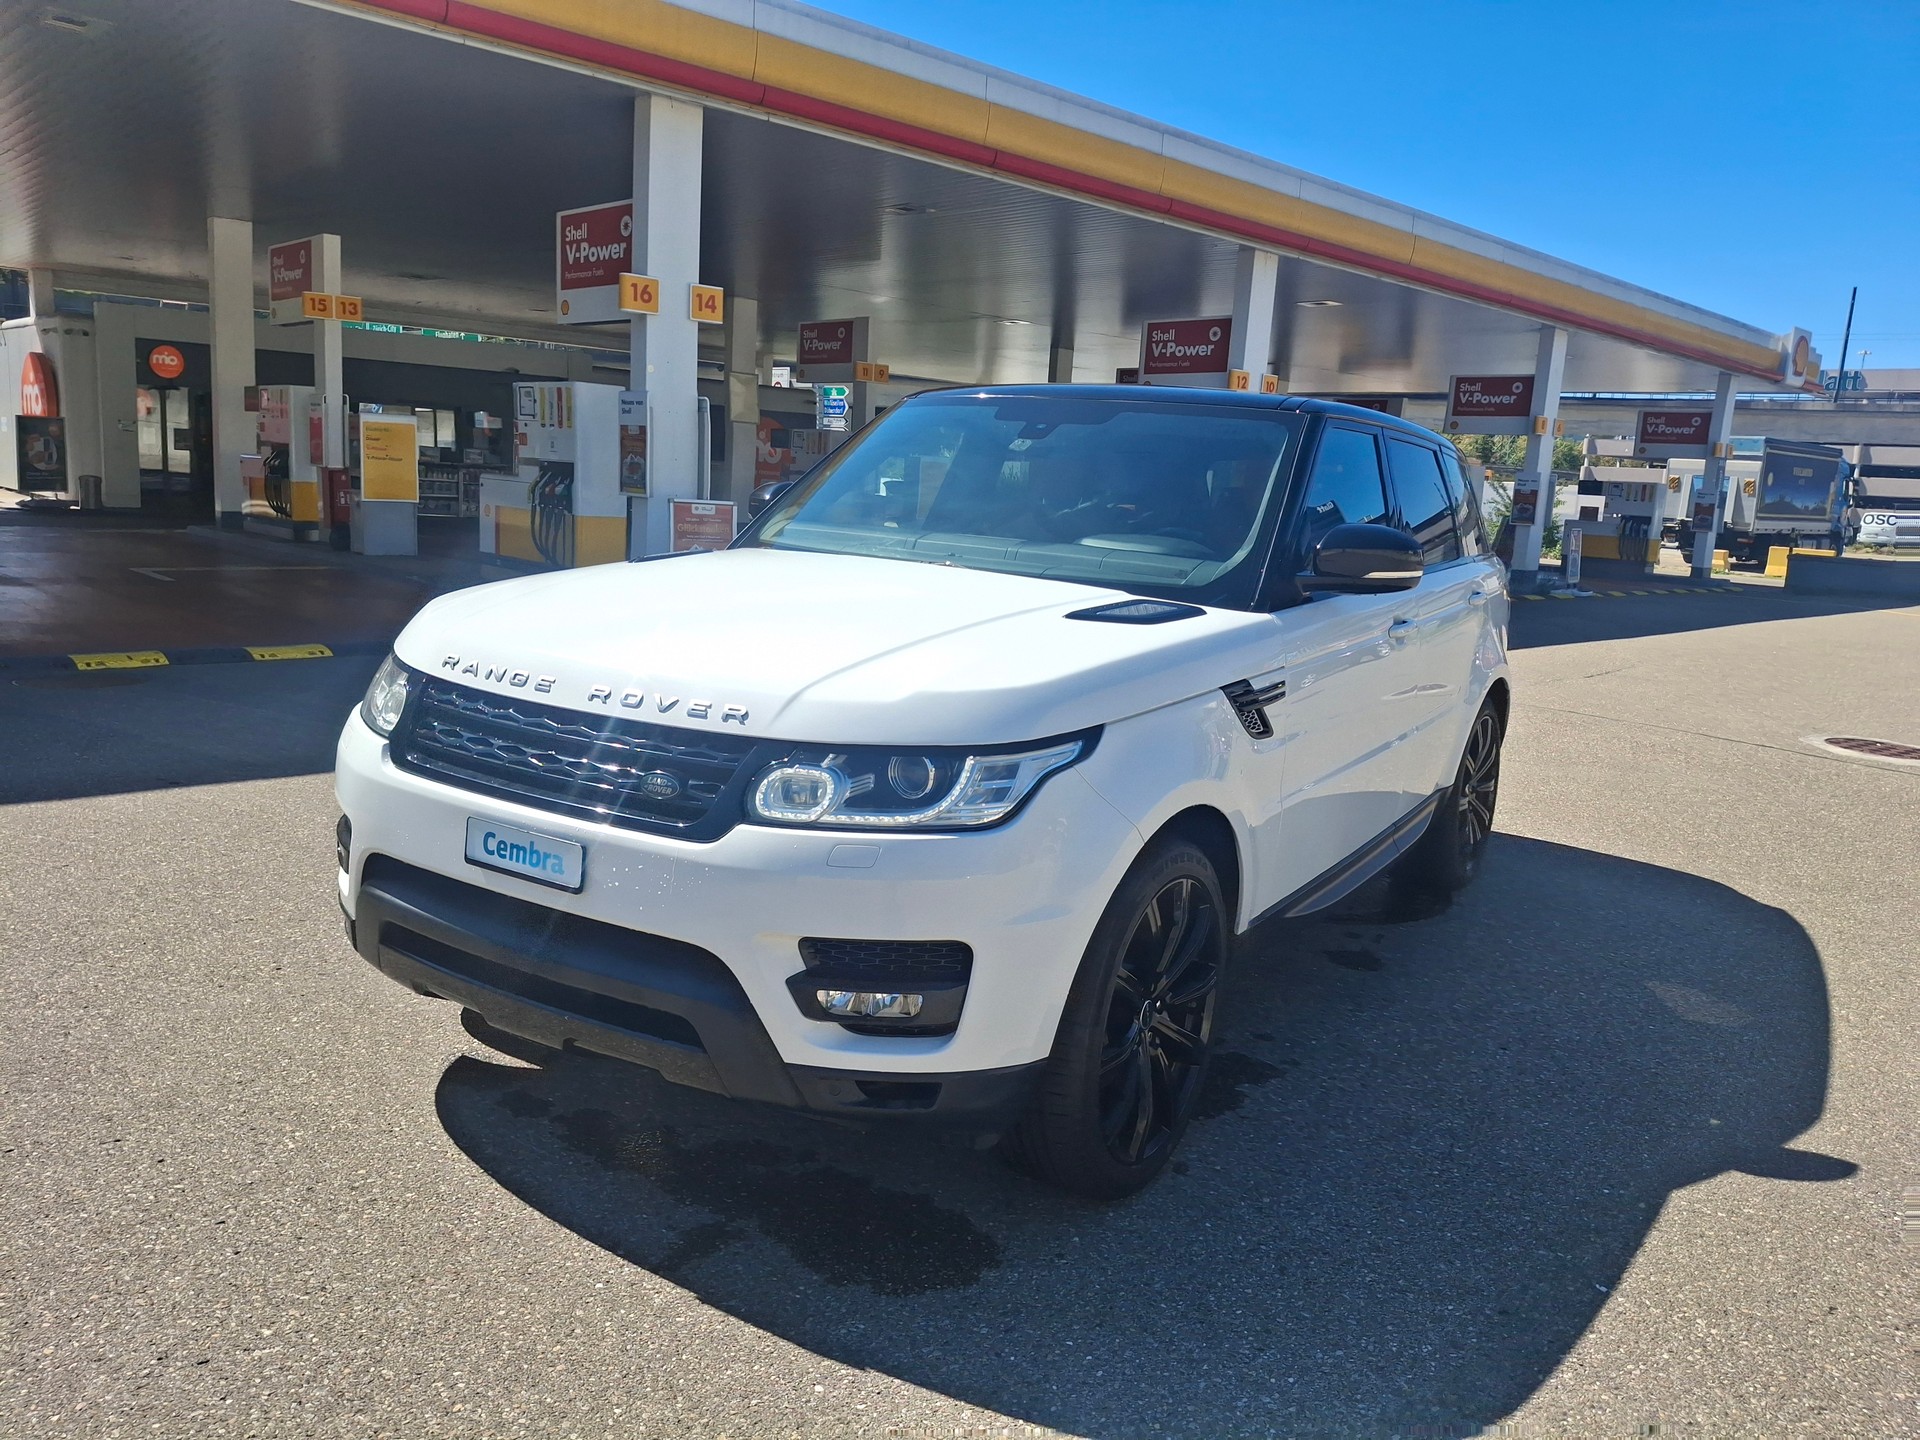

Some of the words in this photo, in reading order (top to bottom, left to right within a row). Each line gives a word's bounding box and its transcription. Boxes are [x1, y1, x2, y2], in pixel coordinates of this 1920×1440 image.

[565, 223, 588, 242] Shell
[566, 242, 627, 265] V-Power
[630, 283, 653, 304] 16
[310, 298, 327, 312] 15
[340, 301, 358, 316] 13
[695, 293, 717, 314] 14
[1152, 329, 1175, 342] Shell
[803, 339, 842, 351] V-Power
[1152, 342, 1215, 358] V-Power
[152, 352, 178, 366] mio
[862, 367, 869, 377] 11
[879, 369, 885, 379] 9
[1236, 375, 1248, 389] 12
[1266, 380, 1275, 393] 10
[1460, 382, 1482, 392] Shell
[1820, 370, 1864, 392] latt
[1460, 392, 1517, 404] V-Power
[1647, 416, 1666, 424] Shell
[1647, 424, 1696, 434] V-Power
[442, 653, 556, 693] RANGE
[587, 684, 750, 726] ROVER
[647, 776, 668, 786] LAND
[647, 784, 673, 795] ROVER
[482, 831, 565, 877] Cembra
